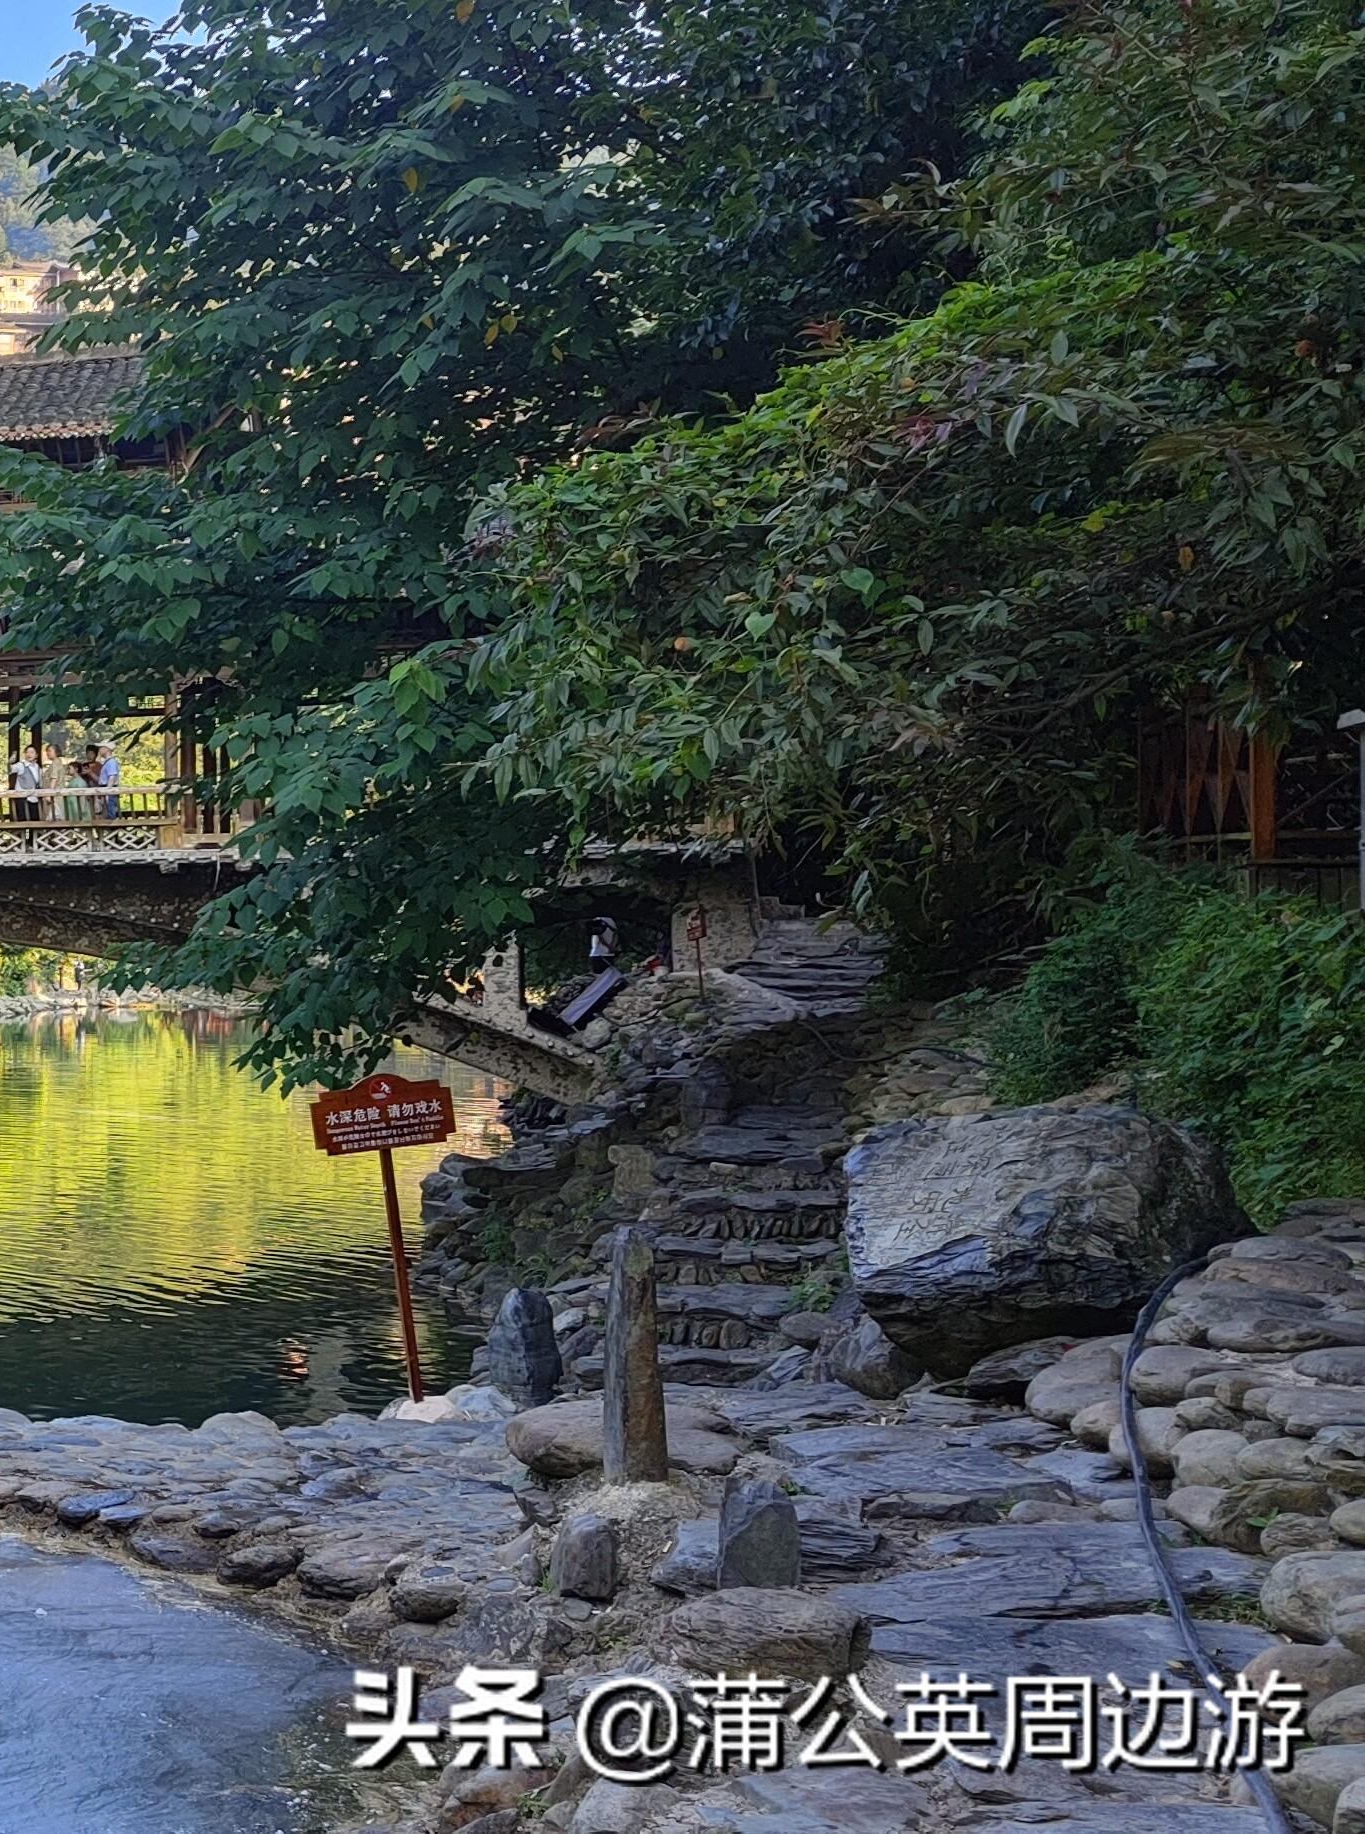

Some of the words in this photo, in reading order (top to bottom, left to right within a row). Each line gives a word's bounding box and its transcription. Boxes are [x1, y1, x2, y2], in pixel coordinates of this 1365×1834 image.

[325, 1106, 381, 1126] 水深危险
[387, 1099, 442, 1118] 请勿戏水
